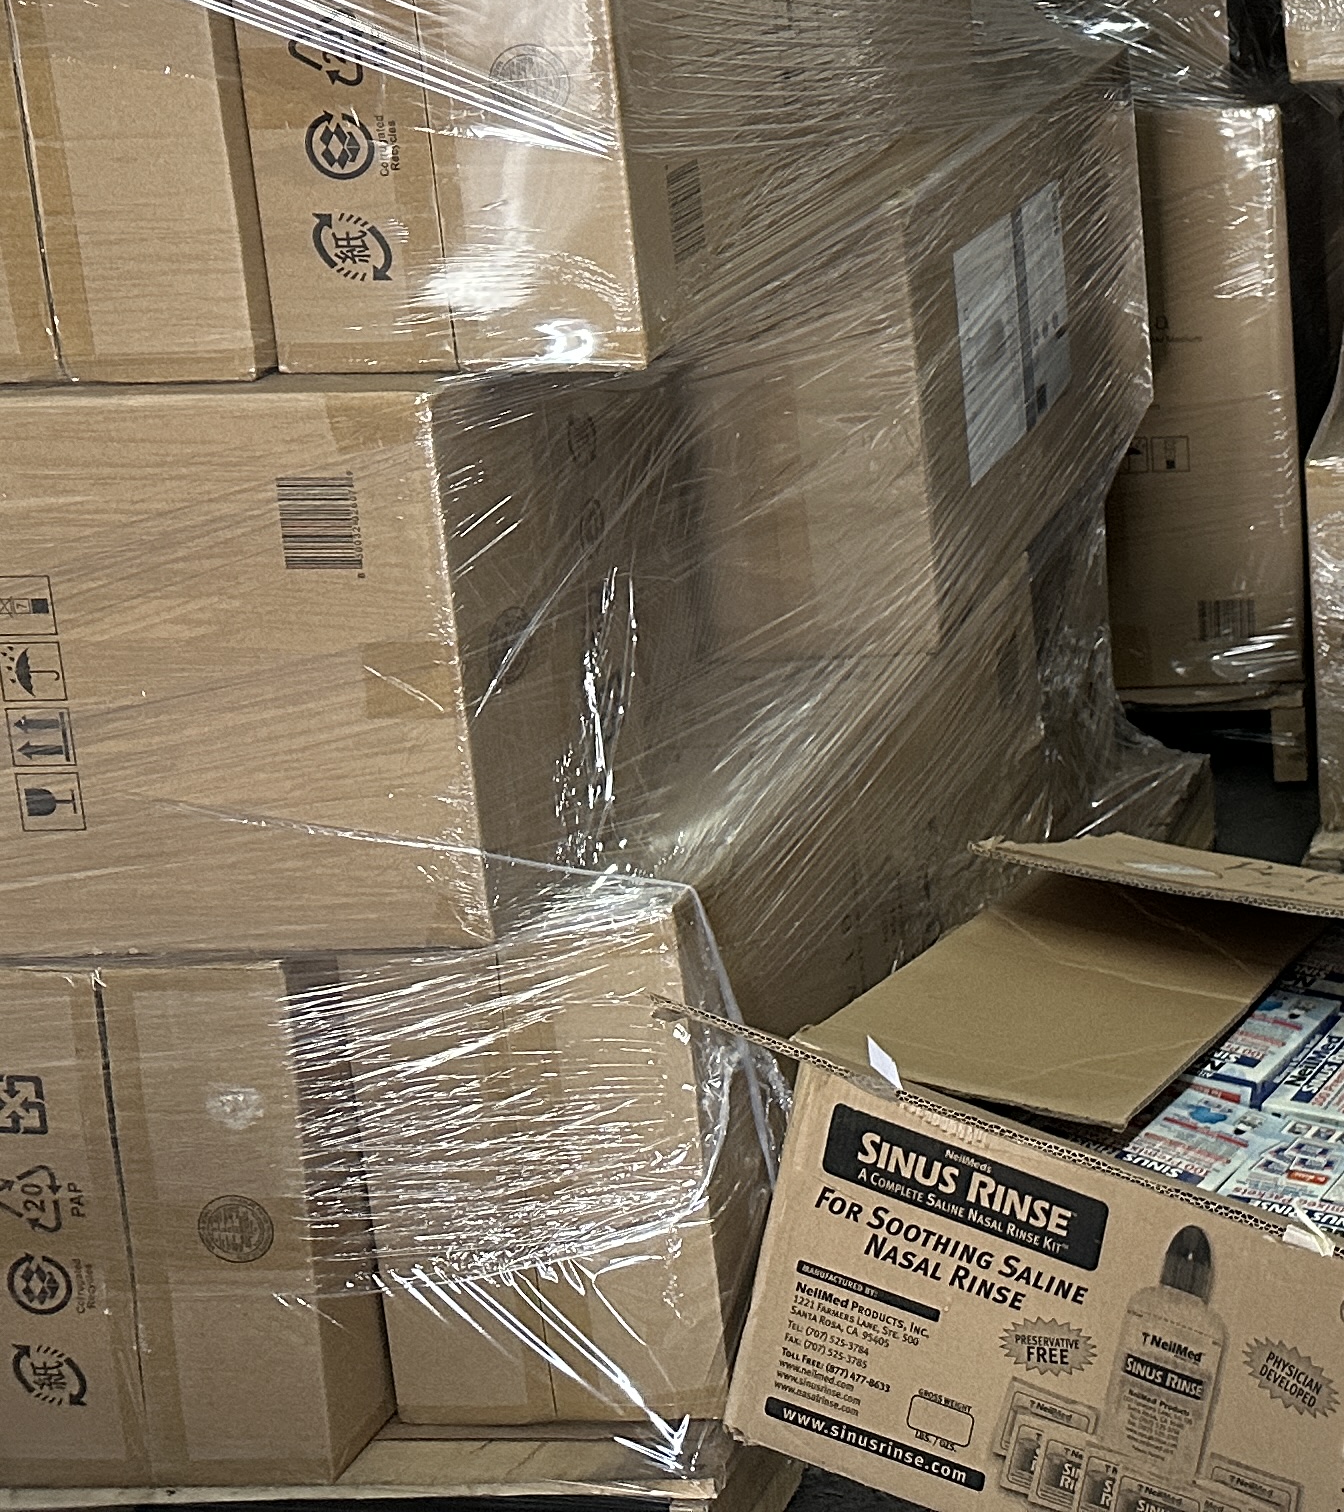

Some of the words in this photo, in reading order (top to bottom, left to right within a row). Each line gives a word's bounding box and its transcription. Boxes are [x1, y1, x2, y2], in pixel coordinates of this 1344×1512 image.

[1284, 1035, 1343, 1086] NeilMed
[1302, 1064, 1339, 1093] SINUS
[857, 1168, 868, 1182] A
[857, 1131, 960, 1195] SINUS
[965, 1170, 1075, 1237] RINSE
[1122, 1153, 1184, 1179] SINUS
[69, 1182, 85, 1218] PAP
[814, 1186, 864, 1224] FOR
[866, 1205, 996, 1270] SOOTHING
[998, 1254, 1089, 1306] SALINE
[801, 1264, 864, 1293] MANUFACTURED
[864, 1234, 942, 1281] NASAL
[949, 1264, 1026, 1311] RINSE
[793, 1294, 815, 1310] 1221
[817, 1303, 855, 1324] FARMERS
[902, 1333, 919, 1346] 500
[795, 1281, 849, 1309] NeilMed
[851, 1300, 908, 1332] PRODUCTS,
[790, 1305, 818, 1322] SANTA
[846, 1325, 859, 1337] CA
[861, 1331, 890, 1348] 95405
[805, 1326, 828, 1341] (707)
[829, 1335, 870, 1357] 525-3784
[1014, 1333, 1080, 1350] PRESERVATIVE
[803, 1339, 826, 1355] (707)
[828, 1348, 867, 1369] 525-3785
[1026, 1347, 1070, 1365] FREE
[1151, 1335, 1202, 1363] NeilMed
[776, 1369, 861, 1406] www.sinusrinse.com
[779, 1359, 855, 1392] www.neilmed.com
[781, 1347, 800, 1362] TOLL
[825, 1360, 848, 1380] (877)
[849, 1371, 891, 1393] 477-8633
[1125, 1357, 1164, 1382] SINUS
[1165, 1371, 1202, 1397] RINSE
[1259, 1365, 1318, 1409] DEVELOPED
[1265, 1351, 1324, 1396] PHYSICIAN
[774, 1380, 859, 1417] www.nasalrinse.com
[918, 1389, 942, 1405] GROSS
[944, 1397, 972, 1413] WEIGHT
[782, 1406, 968, 1483] www.sinusrinse.com
